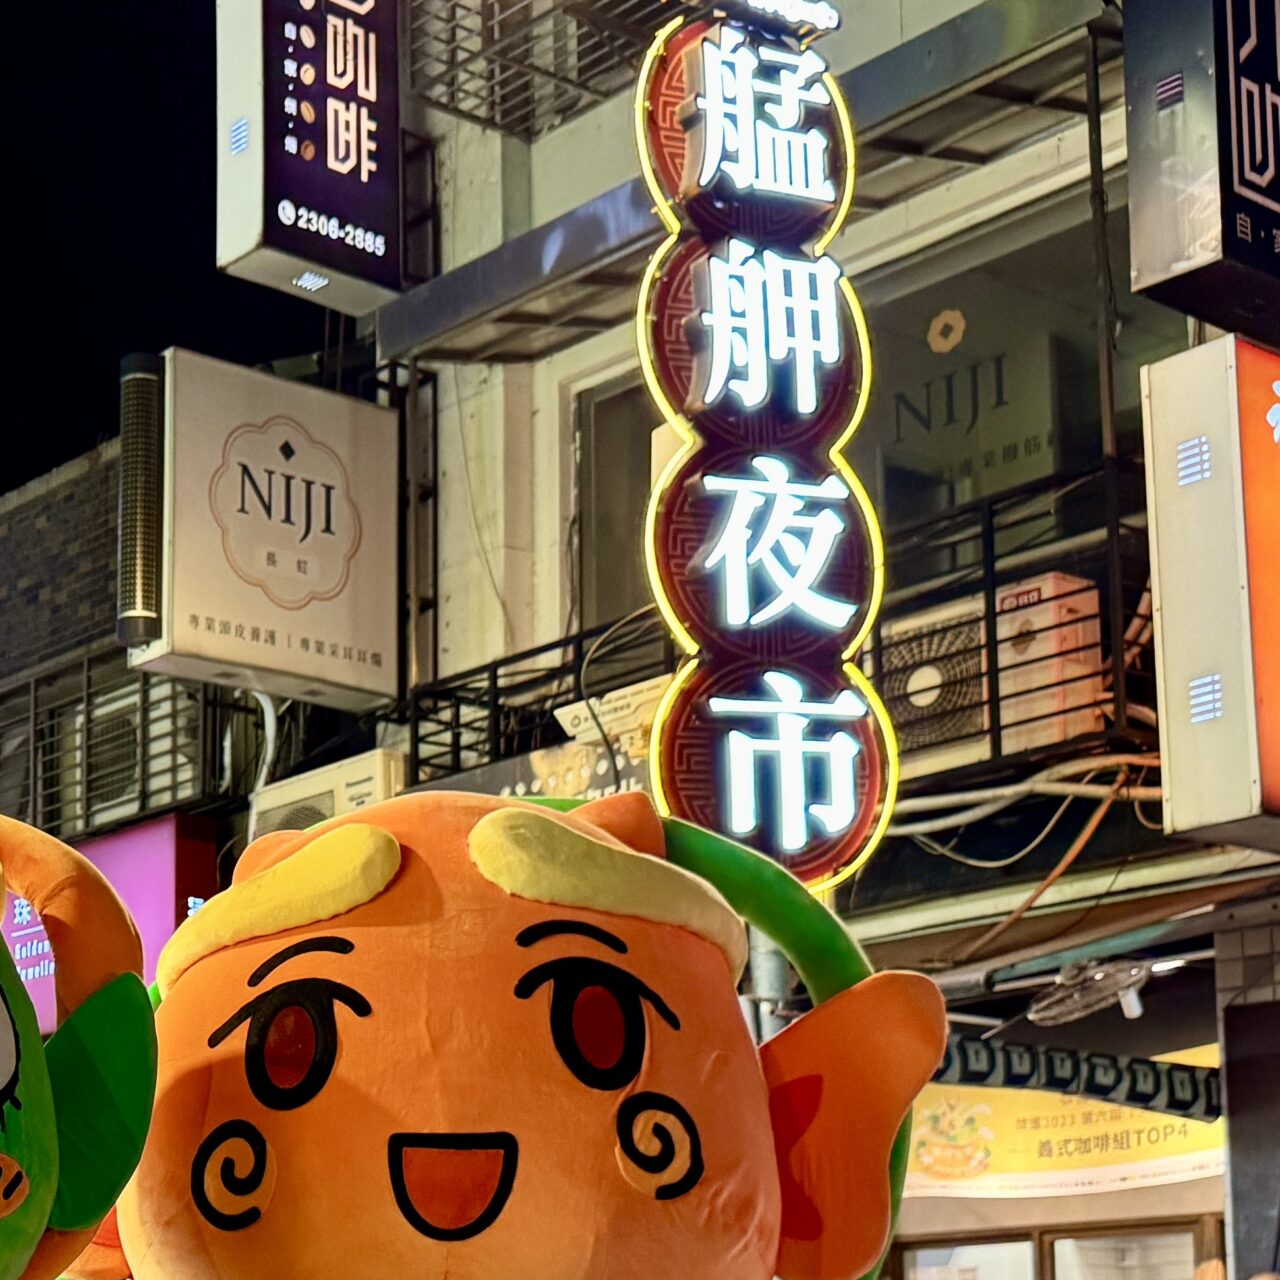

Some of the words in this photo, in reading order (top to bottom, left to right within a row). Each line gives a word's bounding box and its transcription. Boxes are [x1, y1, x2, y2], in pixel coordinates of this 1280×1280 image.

[327, 0, 378, 183] 咖啡
[297, 206, 386, 257] 2306-2885
[697, 25, 869, 851] 艋舺夜市
[894, 353, 1009, 445] NIJI
[236, 461, 336, 544] NIJI
